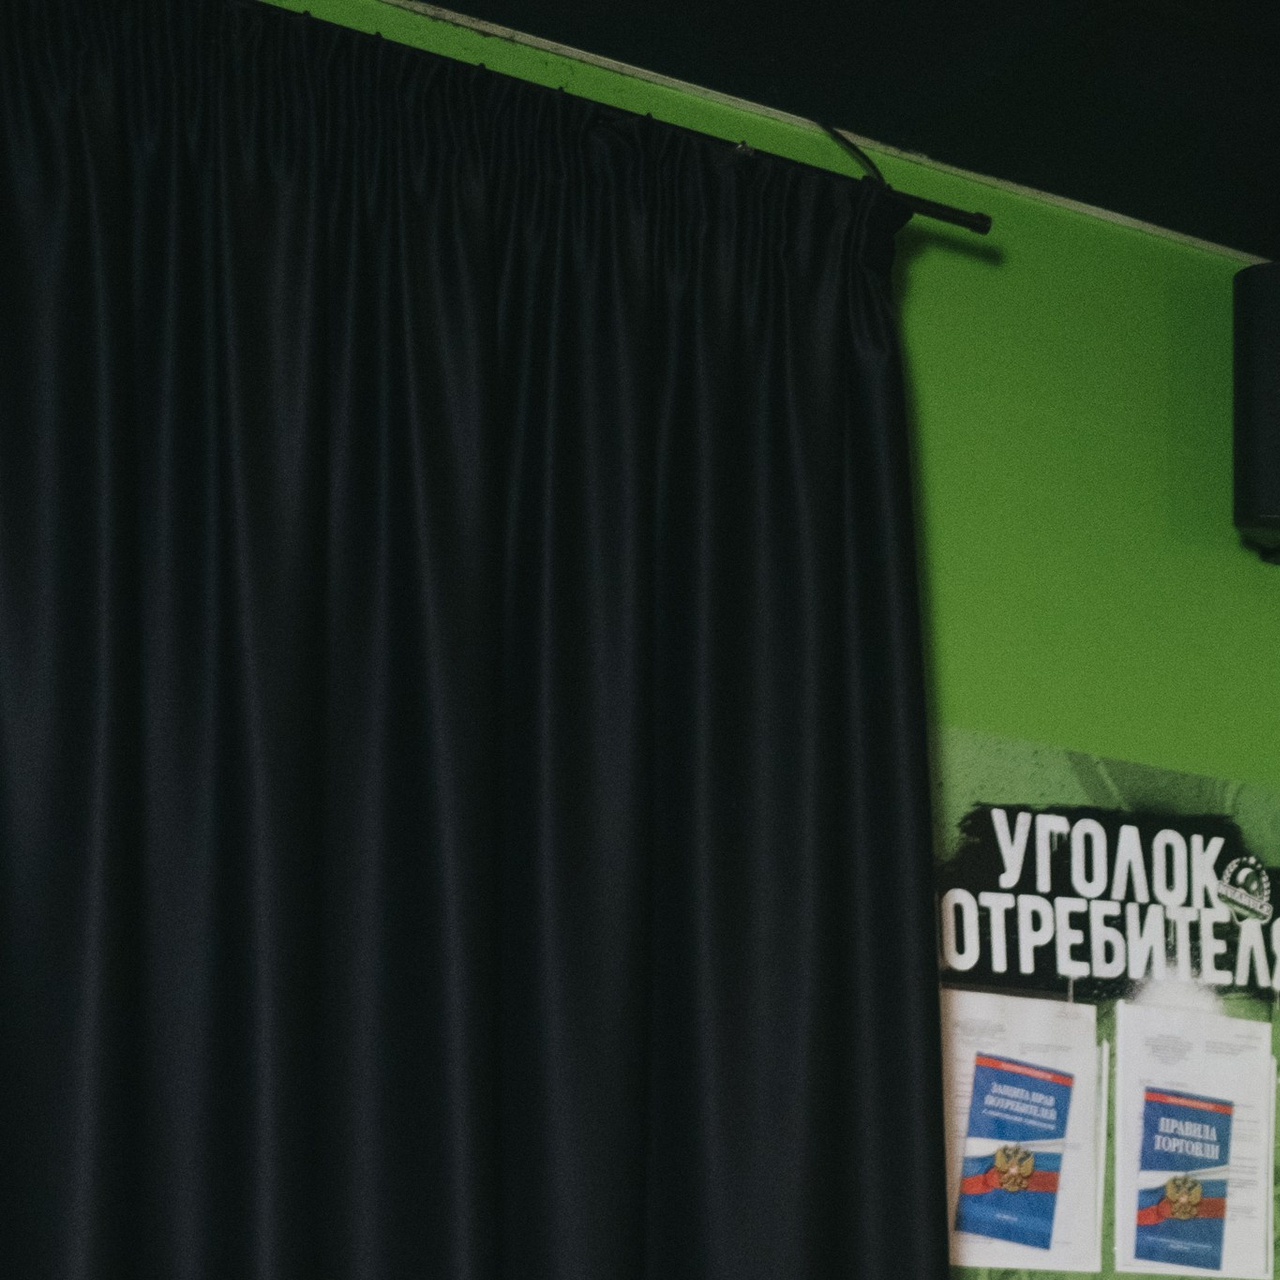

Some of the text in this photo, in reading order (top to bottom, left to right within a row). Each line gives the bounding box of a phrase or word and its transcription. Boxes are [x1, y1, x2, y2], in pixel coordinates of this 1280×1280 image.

[990, 808, 1226, 908] УГОЛОК
[1158, 1116, 1218, 1142] ПРАВИЛА
[1153, 1134, 1220, 1160] ТОРГОВЛИ
